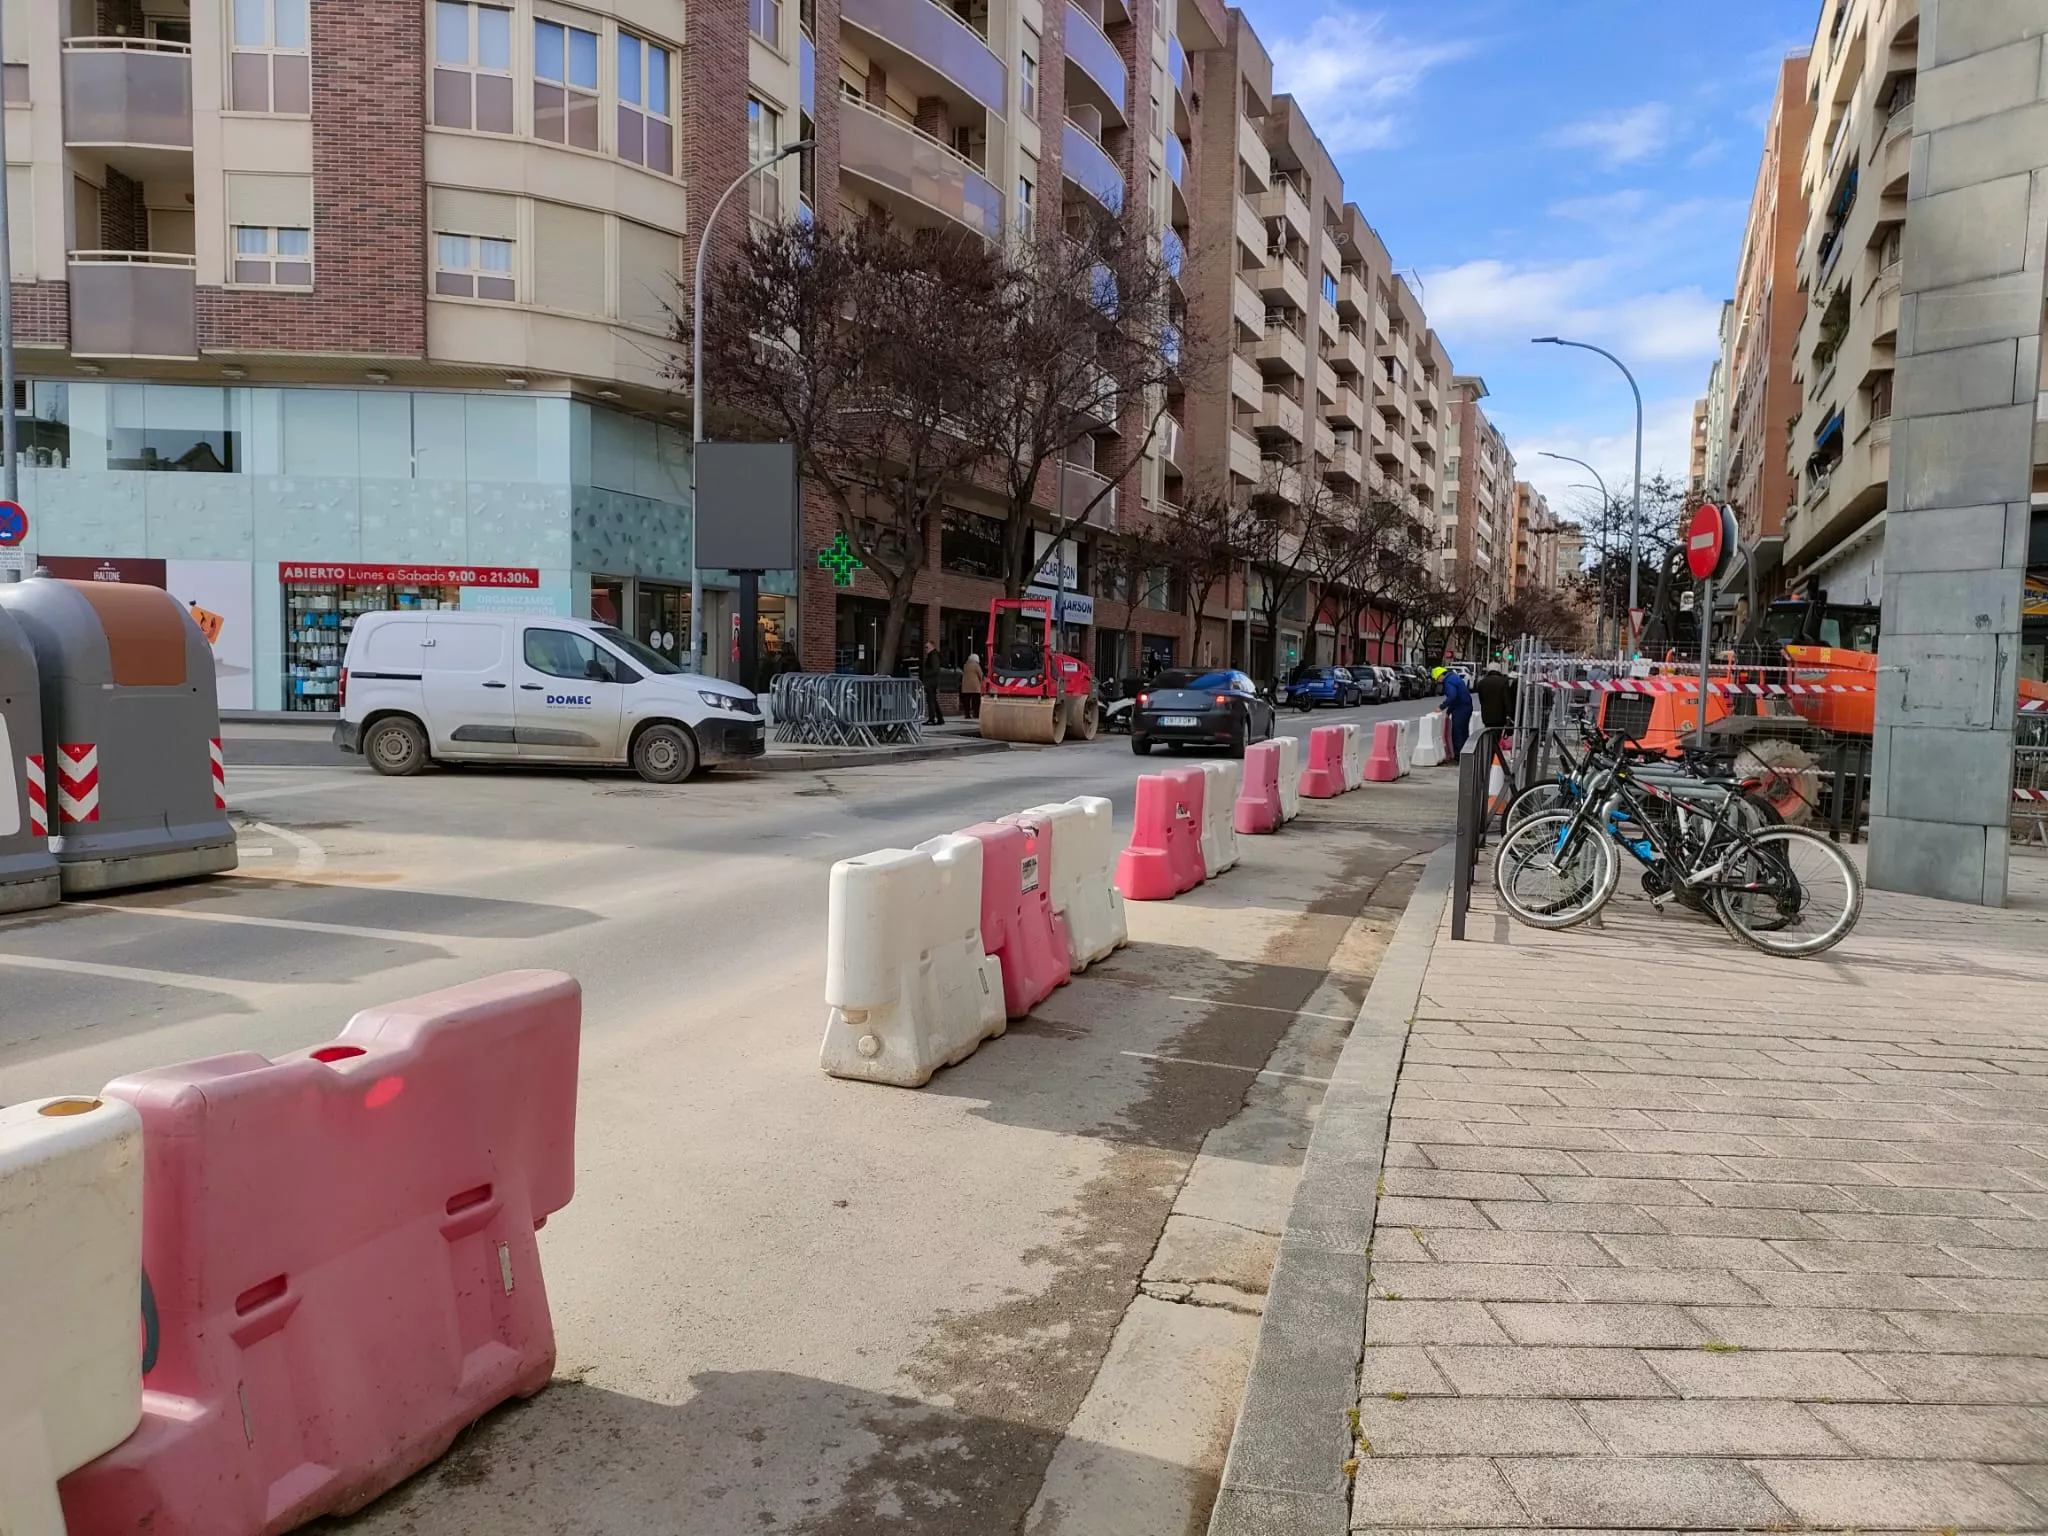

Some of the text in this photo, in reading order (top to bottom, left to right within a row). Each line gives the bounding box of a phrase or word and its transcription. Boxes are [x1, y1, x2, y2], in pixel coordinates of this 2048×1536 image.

[284, 567, 345, 579] ABIERTO
[348, 568, 384, 580] Lunes
[387, 572, 395, 581] a
[397, 569, 445, 581] Sabado
[447, 571, 476, 582] 9:00
[479, 574, 487, 582] a
[546, 695, 592, 705] DOMEC
